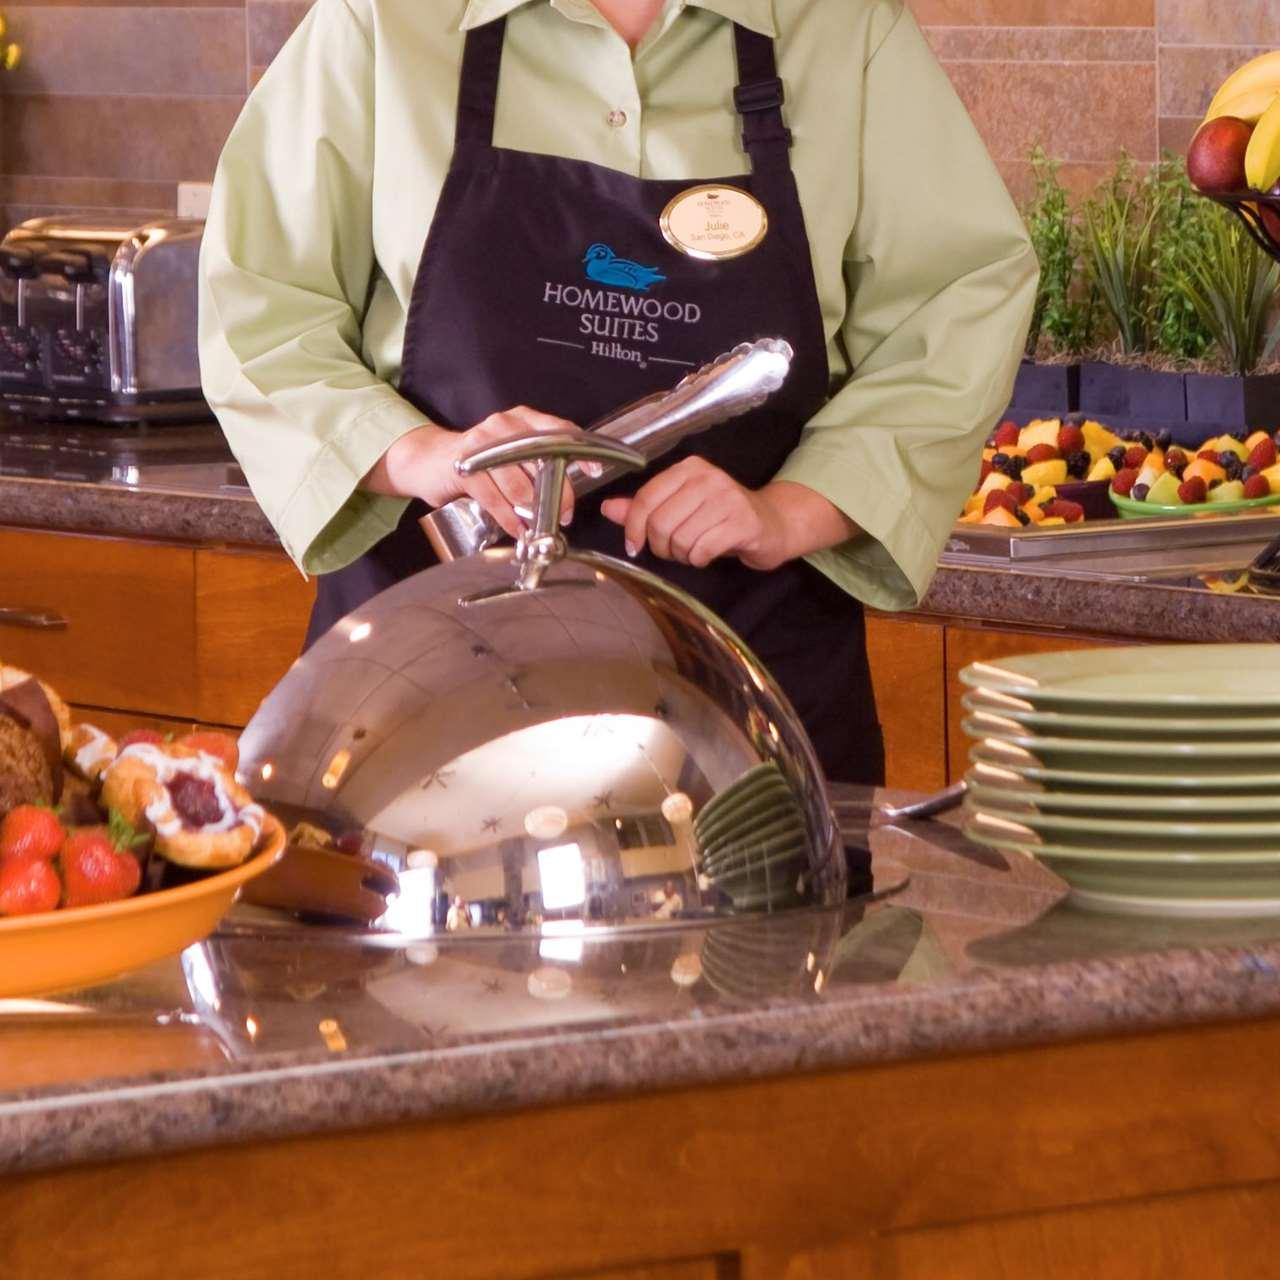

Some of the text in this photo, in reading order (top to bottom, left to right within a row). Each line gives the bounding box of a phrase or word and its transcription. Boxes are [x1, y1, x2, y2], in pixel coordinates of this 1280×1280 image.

[543, 282, 701, 323] HOMEWOOD
[578, 314, 659, 343] SUITES
[591, 341, 641, 362] Hilton
